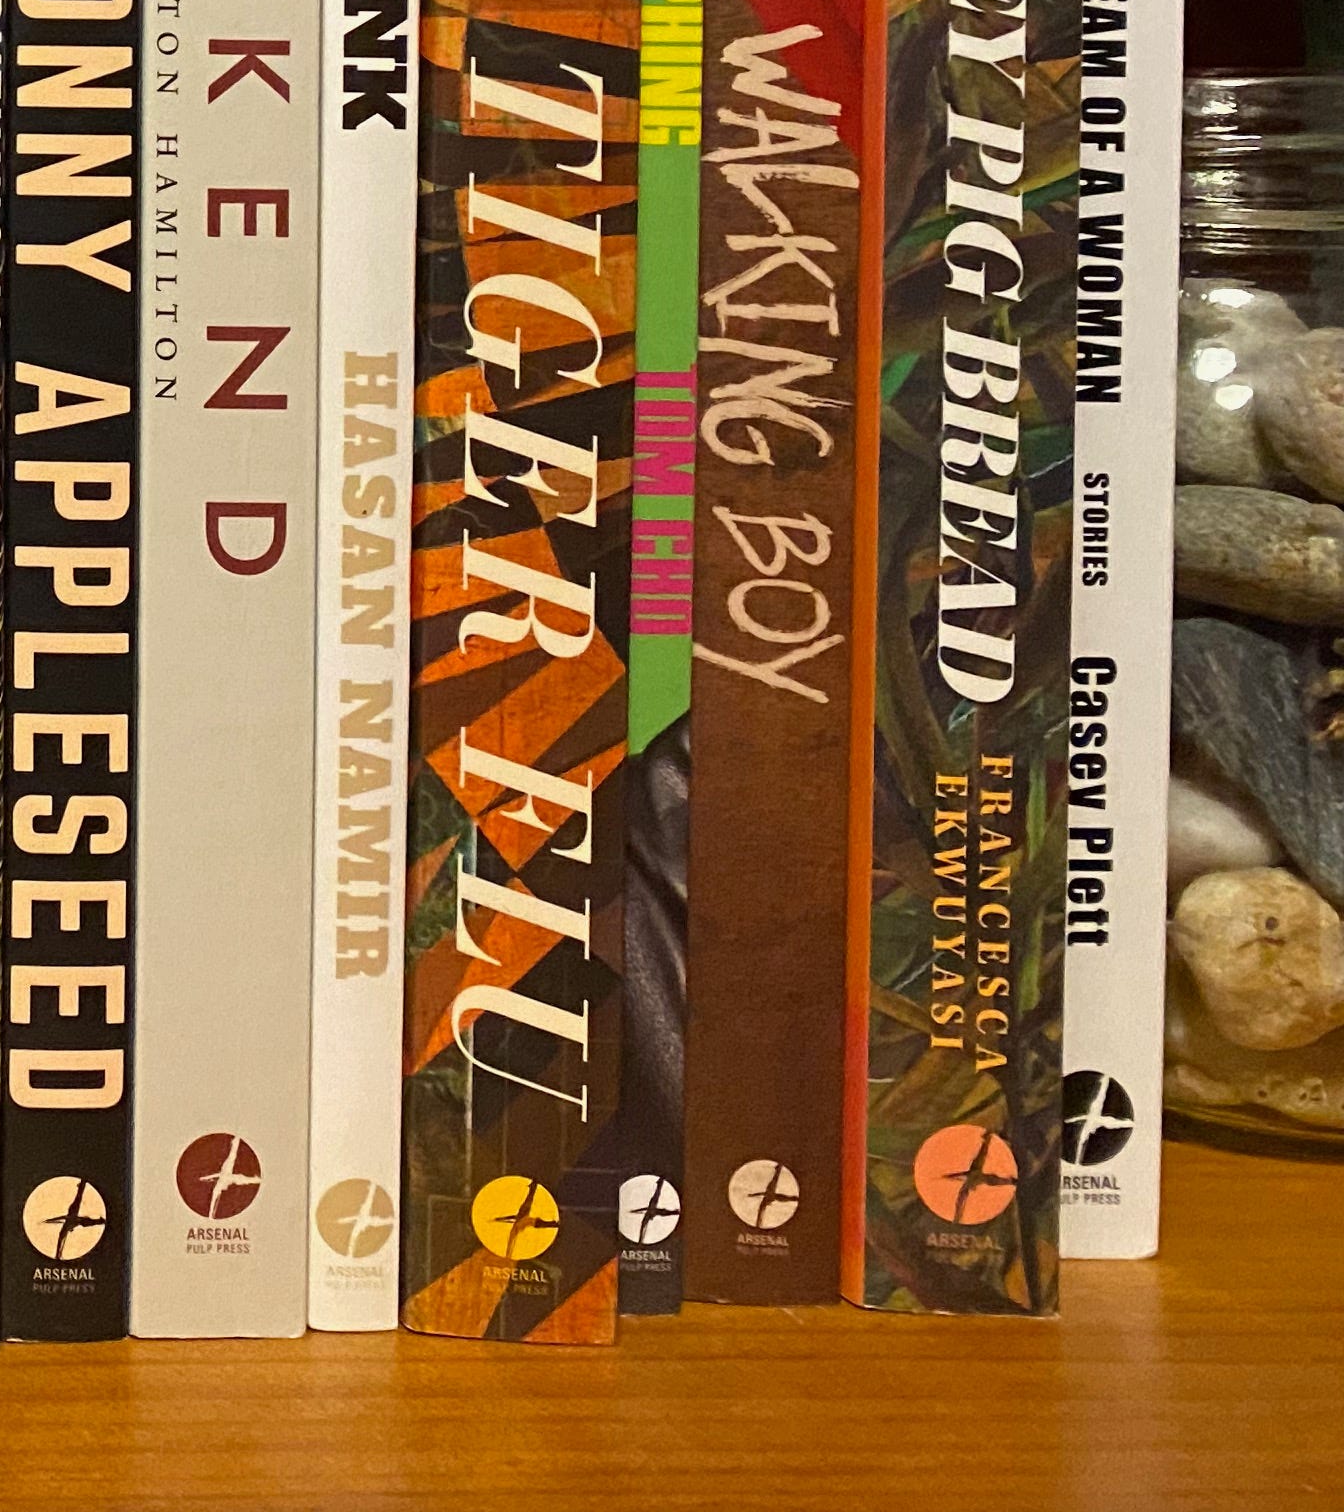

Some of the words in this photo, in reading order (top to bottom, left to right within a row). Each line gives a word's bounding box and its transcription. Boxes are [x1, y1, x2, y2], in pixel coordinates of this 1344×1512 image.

[154, 134, 179, 402] HAMILTON
[460, 57, 607, 667] TIGER
[696, 26, 859, 460] WALKING
[942, 107, 1027, 300] PIG
[693, 513, 845, 707] BOY
[932, 318, 1023, 705] BREAD
[9, 361, 130, 1109] APPLESEED
[457, 727, 593, 1120] FLU
[928, 774, 967, 1050] EKWUYASI
[974, 754, 1011, 1070] FRANCESCA
